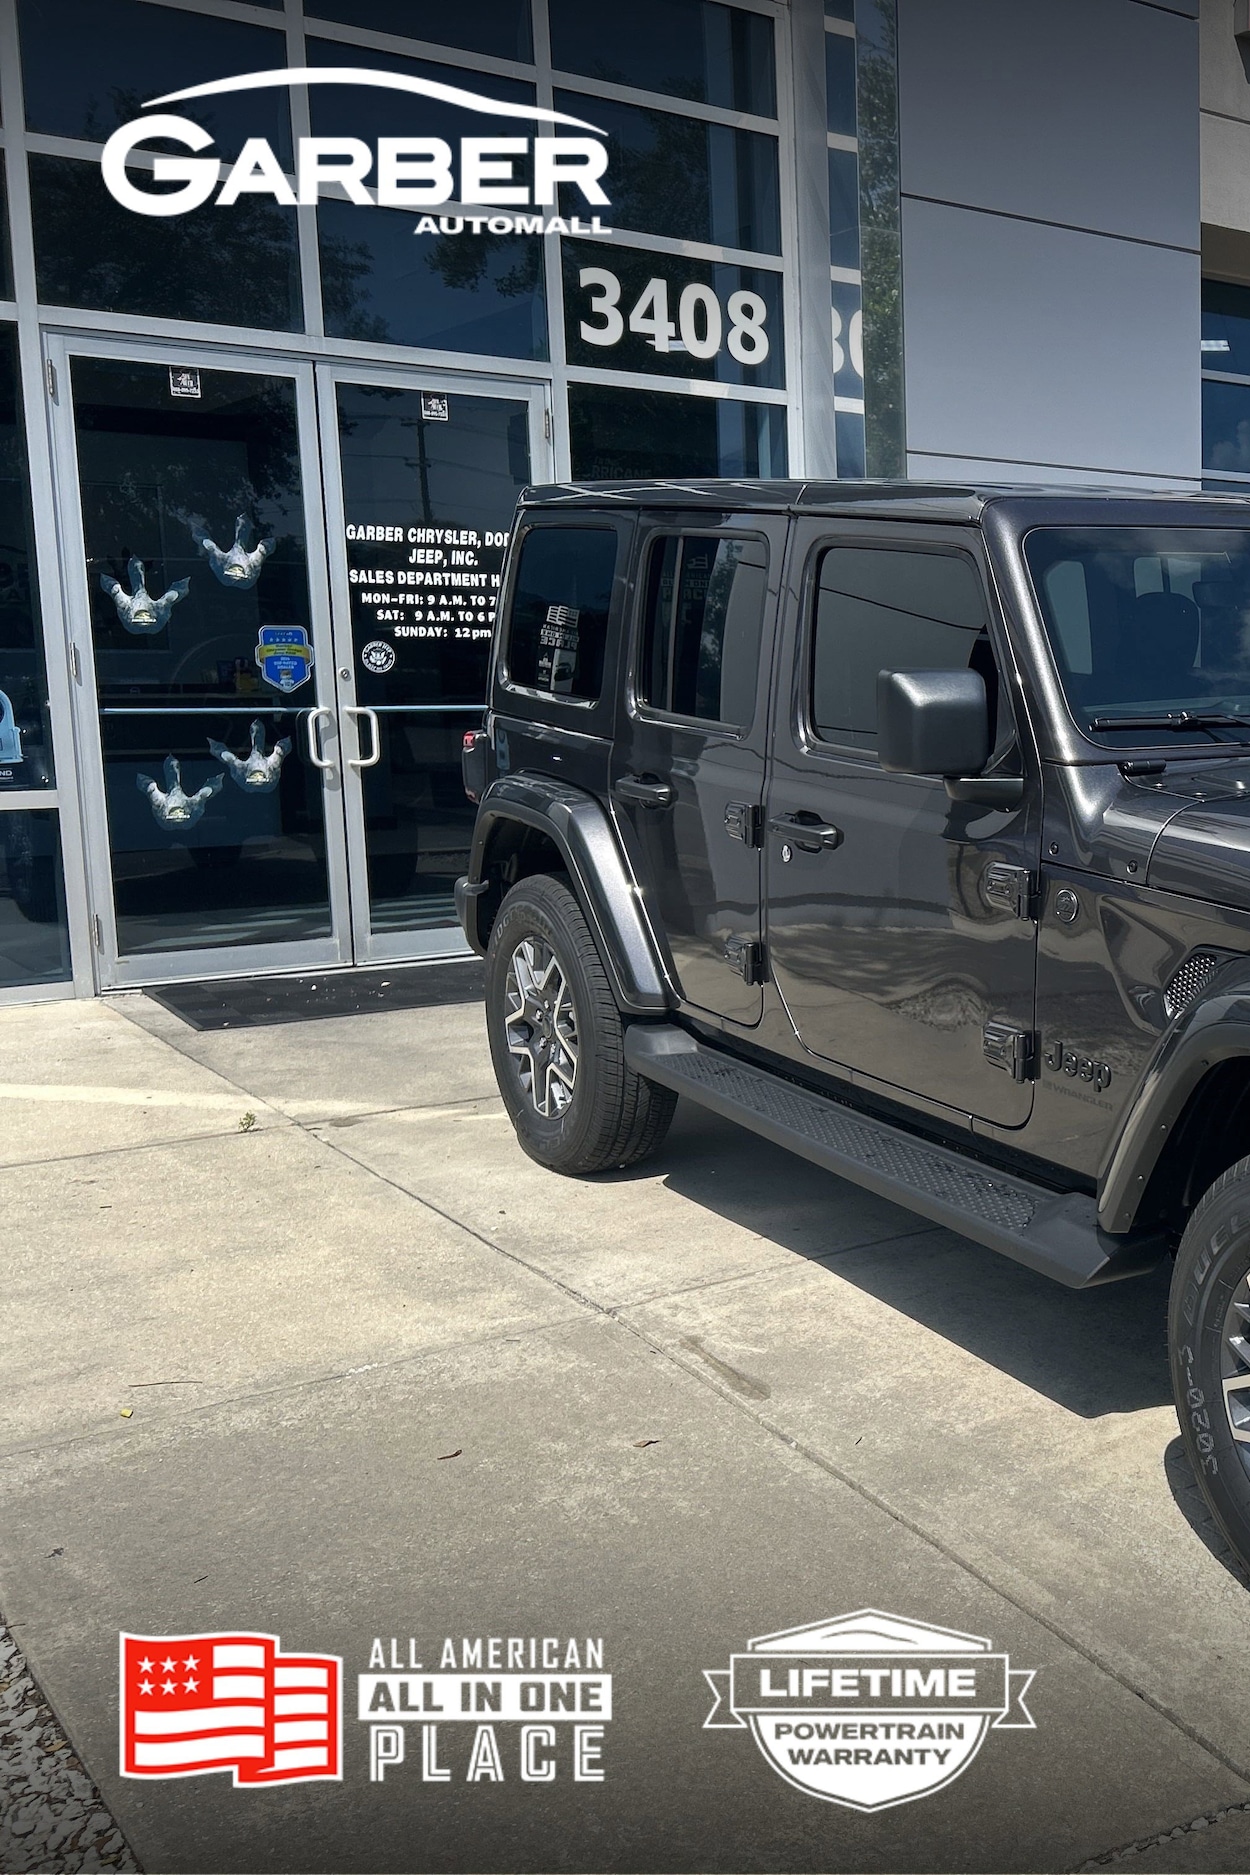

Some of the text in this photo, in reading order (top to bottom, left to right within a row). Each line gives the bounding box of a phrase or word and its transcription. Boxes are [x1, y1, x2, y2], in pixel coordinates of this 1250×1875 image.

[579, 267, 769, 365] 3408
[346, 524, 403, 542] GARBER
[407, 527, 482, 549] CHRYSLER,
[408, 548, 479, 567] JEEP, INC.
[349, 569, 395, 585] SALES
[397, 571, 487, 587] DEPARTMENT
[427, 595, 436, 606] 9
[438, 595, 467, 606] A.M.
[470, 595, 487, 606] TO
[376, 609, 405, 621] SAT:
[414, 610, 423, 621] 9
[426, 610, 455, 622] A.M.
[457, 611, 474, 622] TO
[477, 611, 486, 622] 6
[394, 626, 448, 638] SUNDAY:
[1044, 1040, 1112, 1093] Jeep
